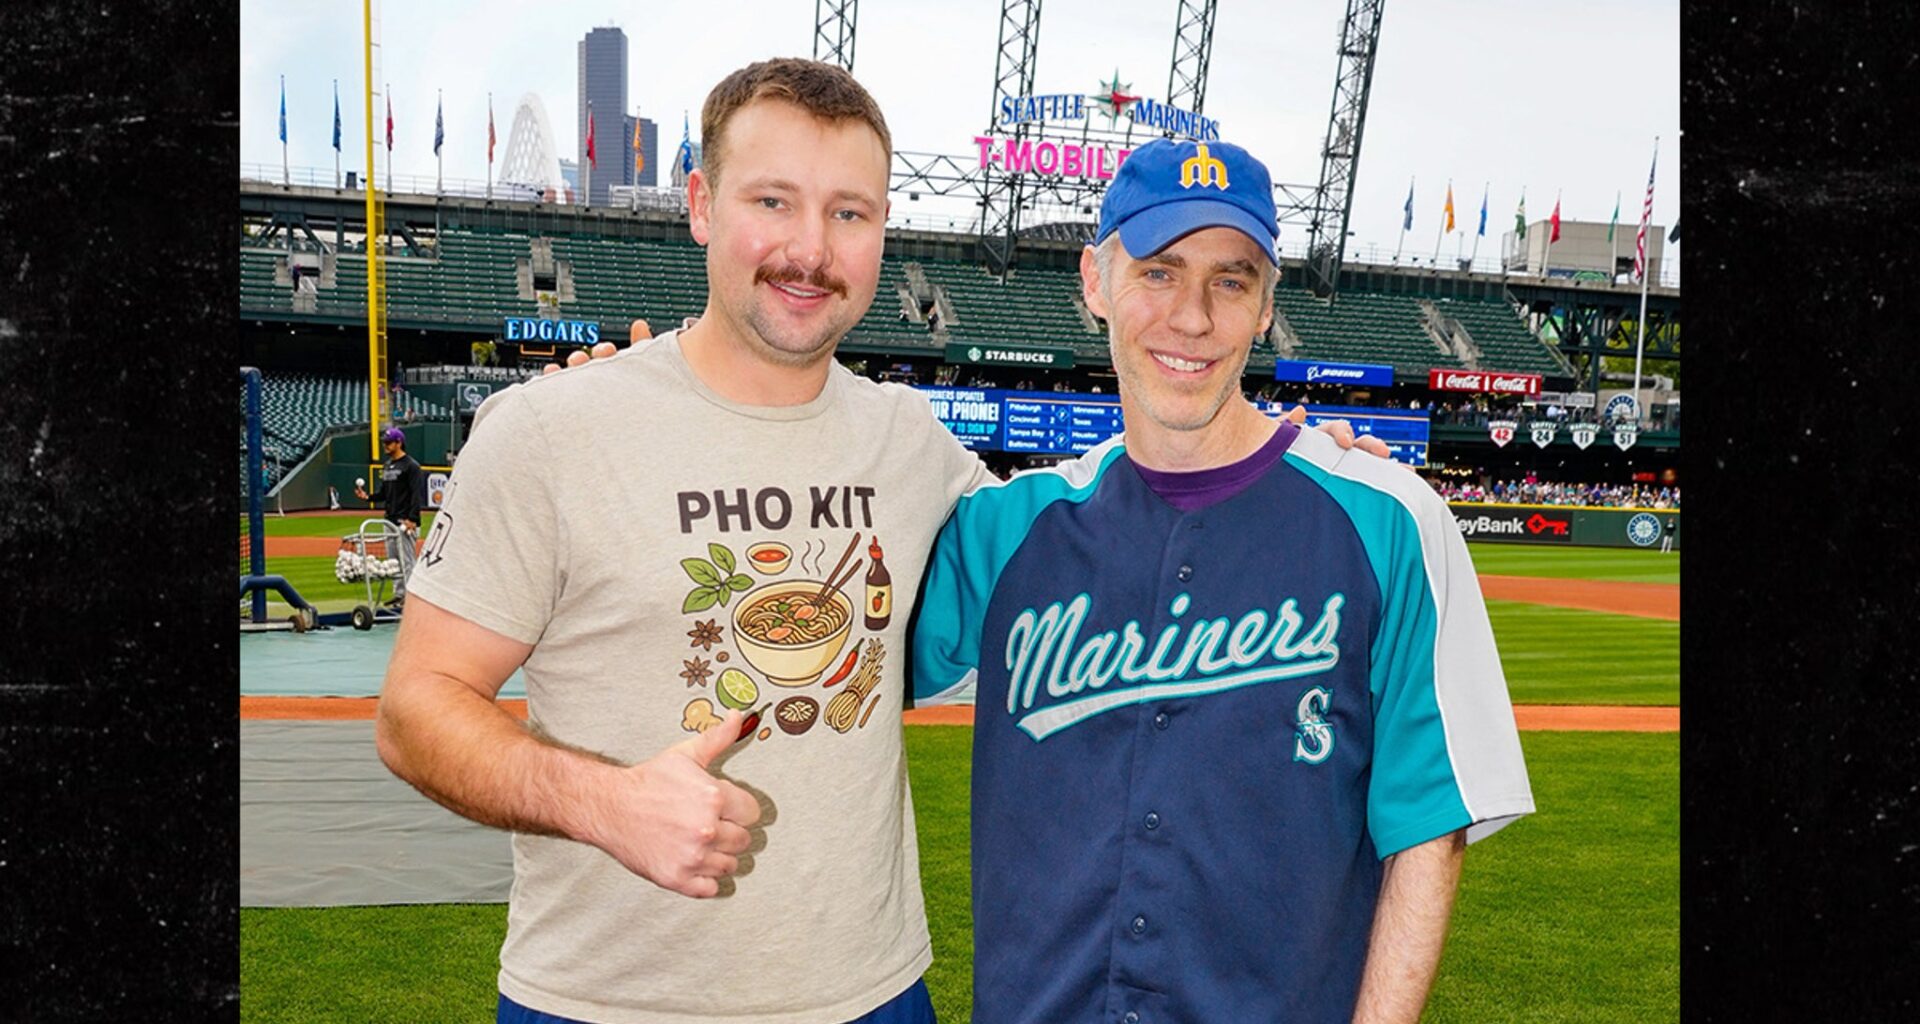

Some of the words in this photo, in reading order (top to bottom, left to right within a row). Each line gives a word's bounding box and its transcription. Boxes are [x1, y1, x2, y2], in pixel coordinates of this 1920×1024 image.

[1001, 95, 1085, 125] SEATTLE
[1135, 98, 1220, 141] MARINERS
[985, 350, 1054, 363] STARBUCKS
[1321, 368, 1364, 378] BOEING
[952, 401, 999, 421] PHONE!
[1495, 429, 1509, 440] 42
[1536, 430, 1549, 441] 24
[1580, 432, 1589, 443] 11
[1620, 433, 1631, 444] 51
[677, 487, 792, 533] PHO
[809, 486, 876, 528] KIT
[1453, 514, 1524, 535] eyBank
[1005, 591, 1346, 716] Mariners
[1292, 685, 1334, 765] S
